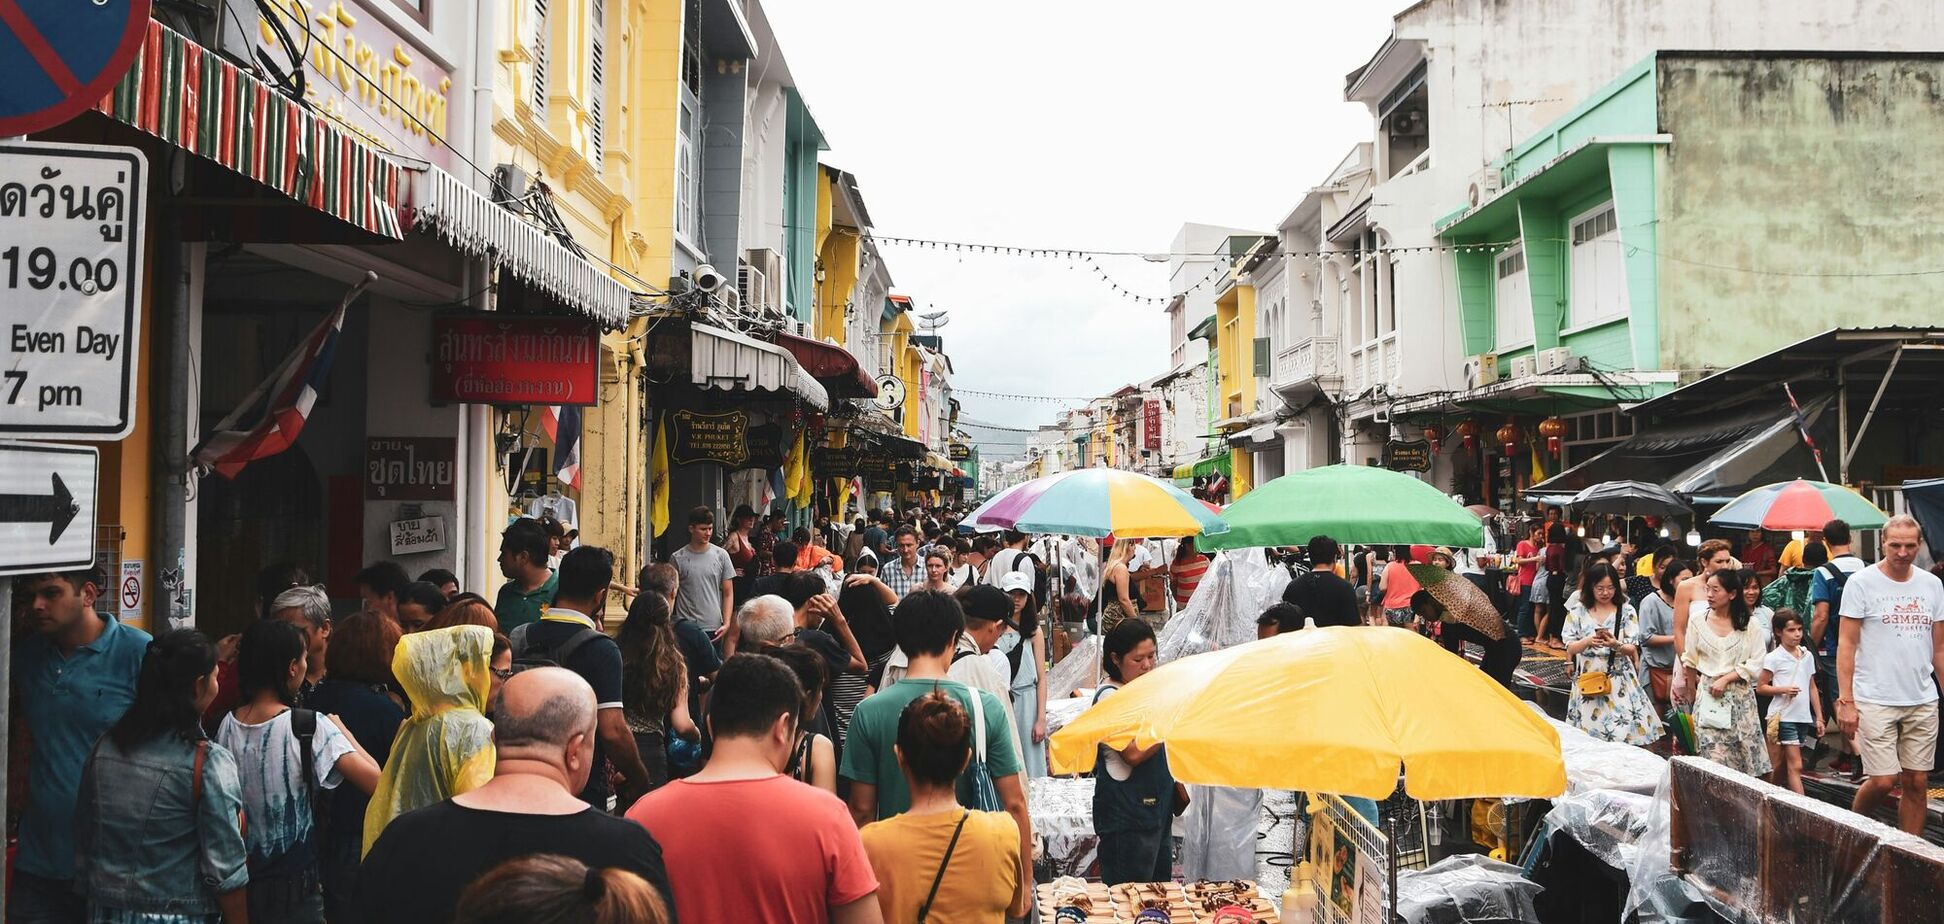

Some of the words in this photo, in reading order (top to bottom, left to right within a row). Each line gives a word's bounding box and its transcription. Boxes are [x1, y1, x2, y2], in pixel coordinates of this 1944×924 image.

[2, 246, 118, 291] 19.00
[11, 324, 64, 353] Even
[76, 326, 119, 361] Day
[4, 371, 28, 405] 7
[39, 384, 82, 412] pm
[371, 440, 402, 450] ขาย
[369, 444, 453, 496] ชุดไทย
